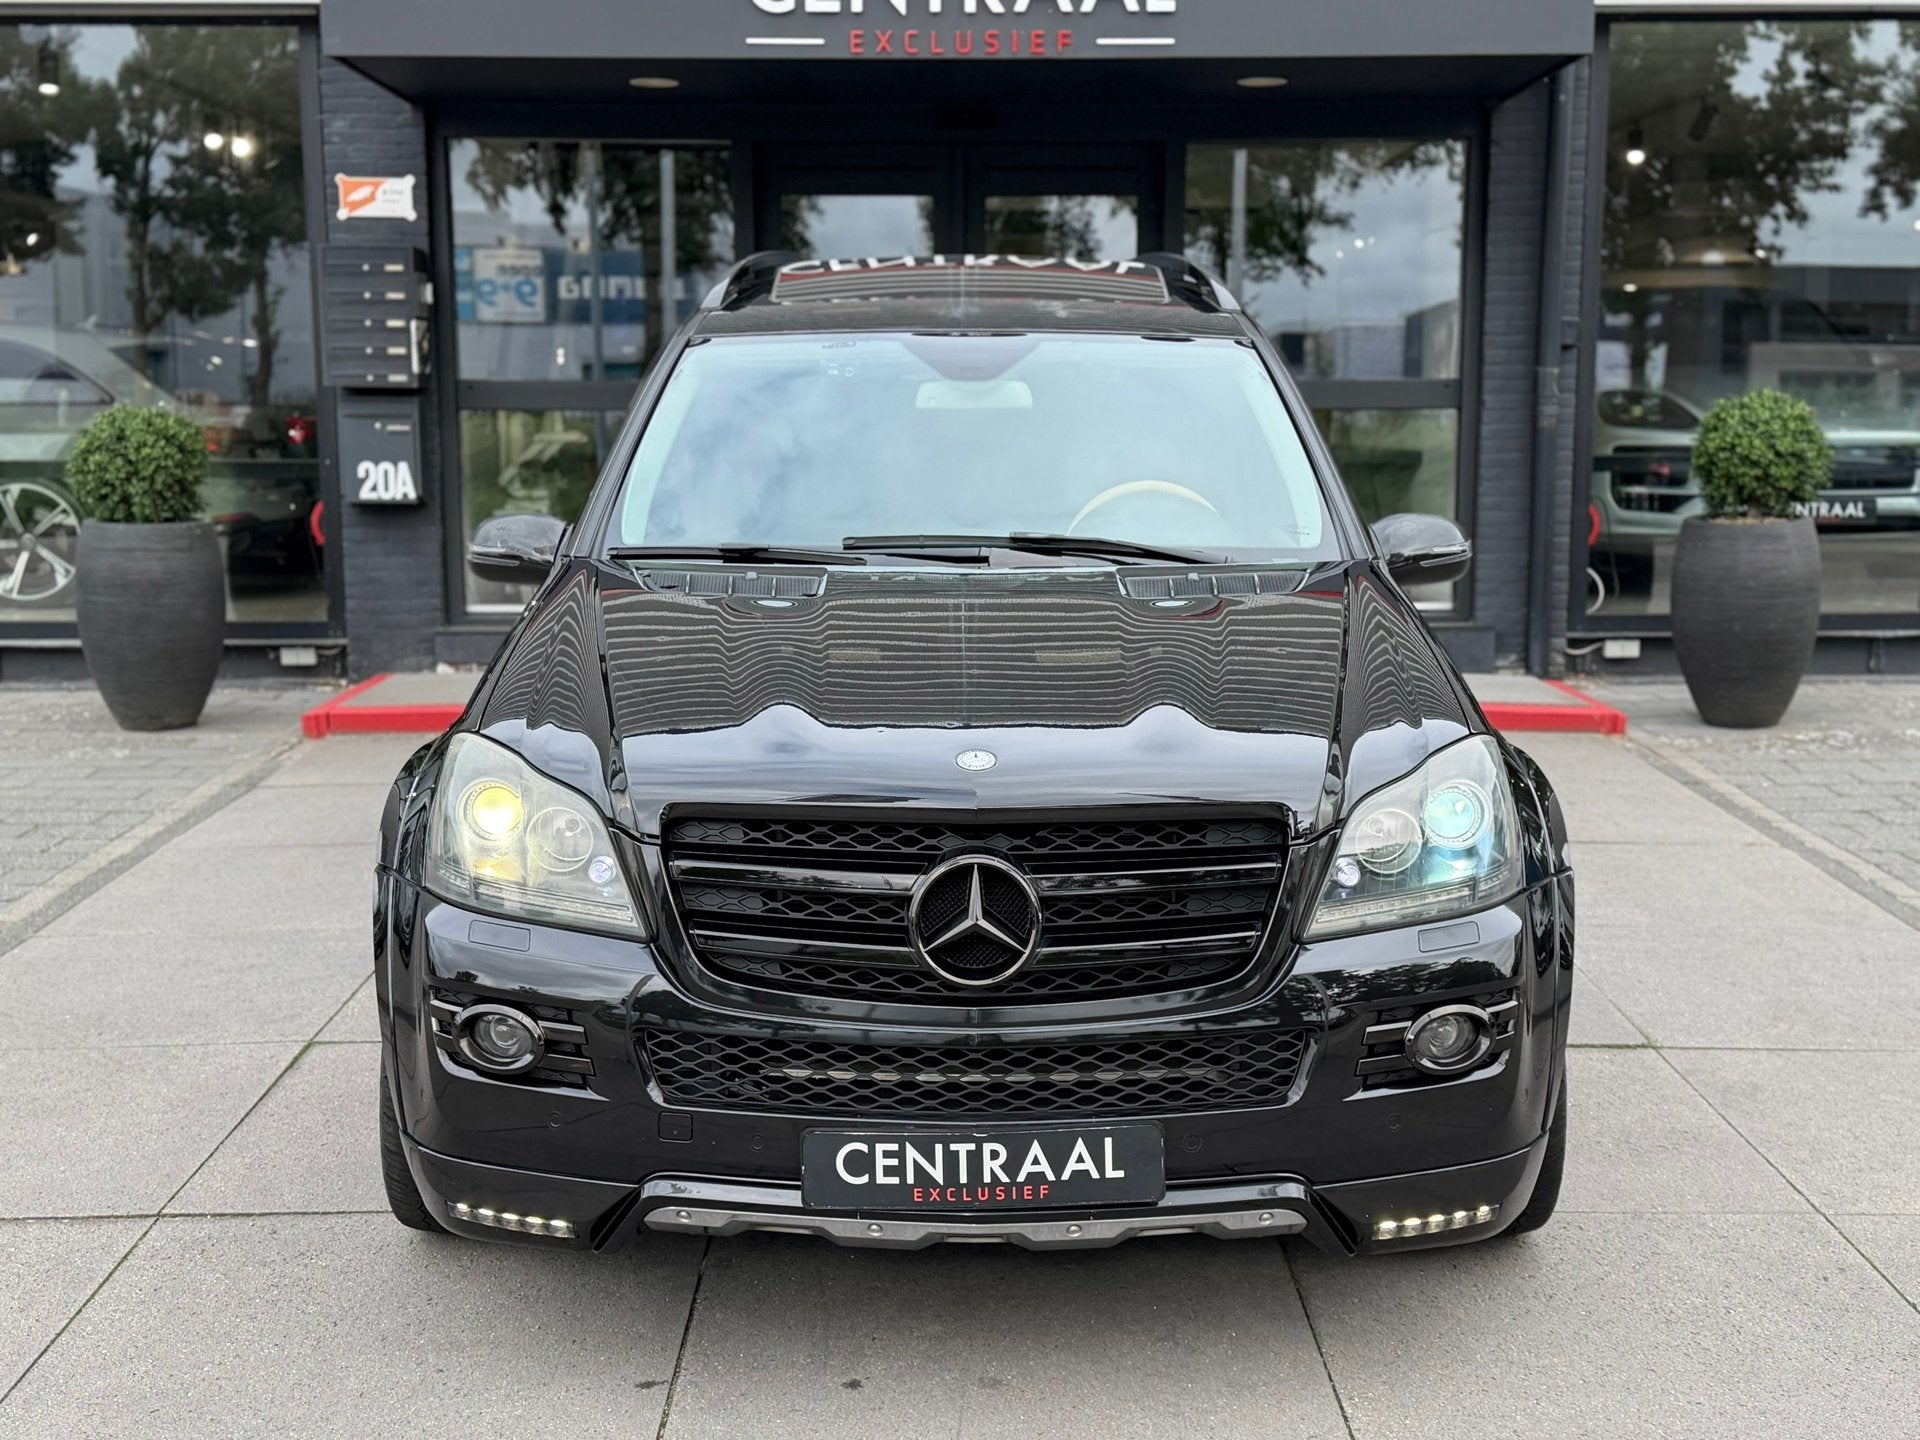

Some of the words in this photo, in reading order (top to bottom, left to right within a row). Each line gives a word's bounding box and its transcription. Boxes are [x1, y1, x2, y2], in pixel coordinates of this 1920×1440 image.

[848, 29, 1073, 54] EXCLUSIEF
[357, 460, 417, 500] 20A
[1791, 501, 1866, 518] NTRAAL
[835, 1137, 1125, 1185] CENTRAAL
[913, 1185, 1050, 1202] EXCLUSIEF
